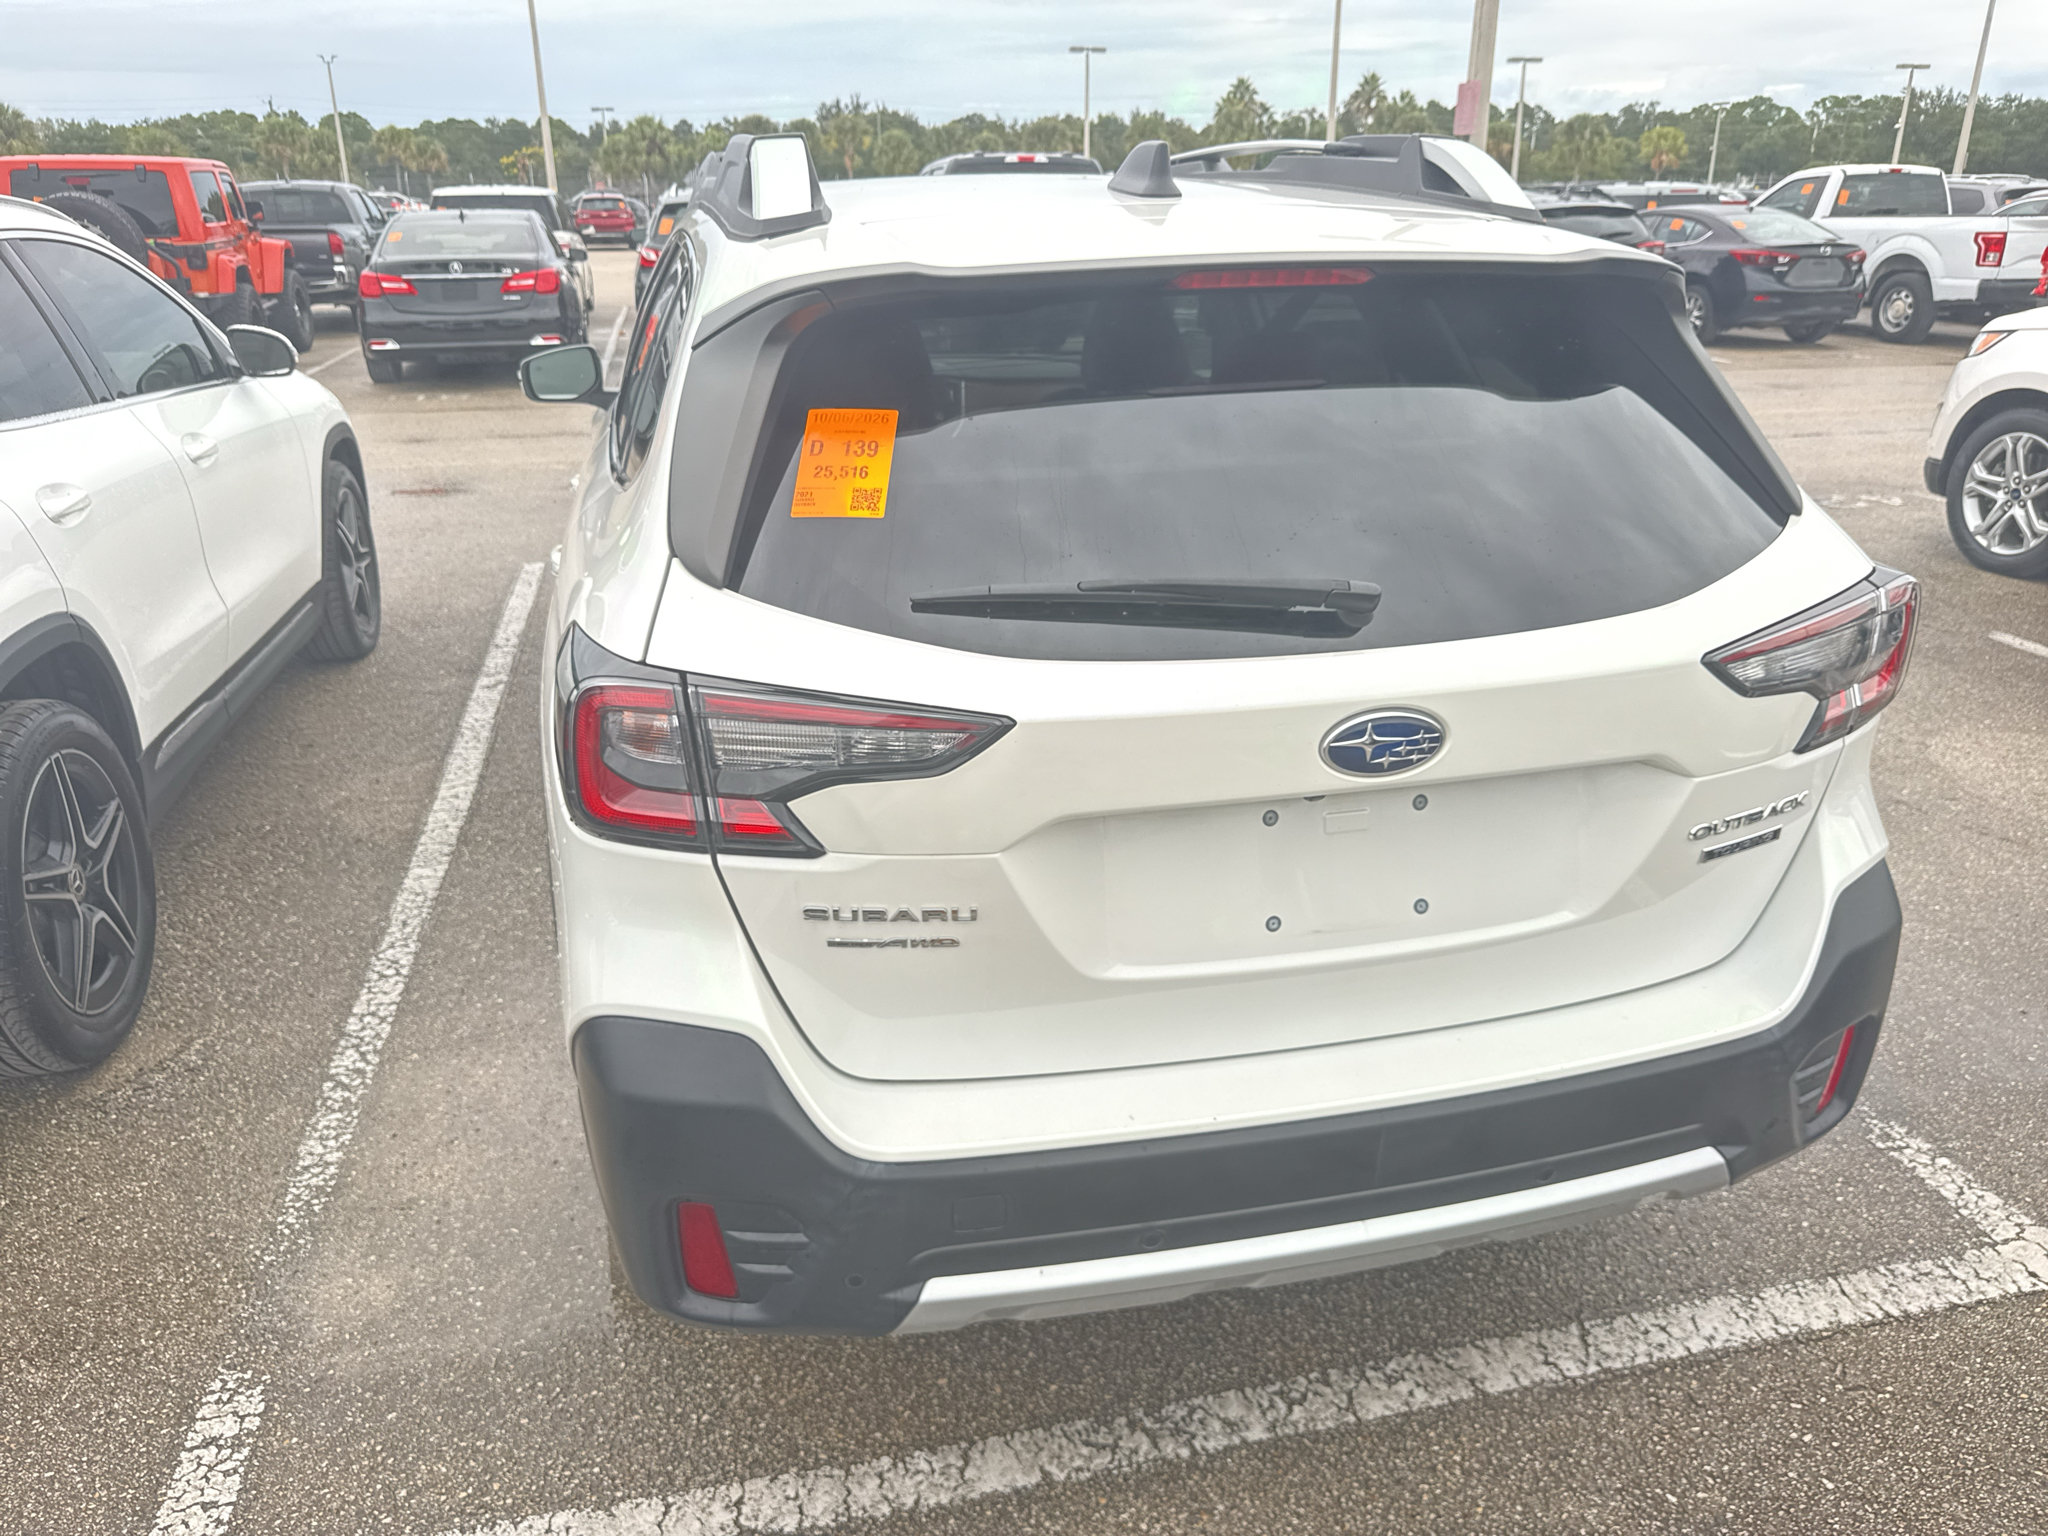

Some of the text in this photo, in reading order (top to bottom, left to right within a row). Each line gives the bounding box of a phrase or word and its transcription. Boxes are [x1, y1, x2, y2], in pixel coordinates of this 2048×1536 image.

[809, 439, 880, 458] D 139
[813, 465, 869, 481] 25,516
[1688, 789, 1809, 841] OUTBACK
[802, 905, 978, 922] SUBARU
